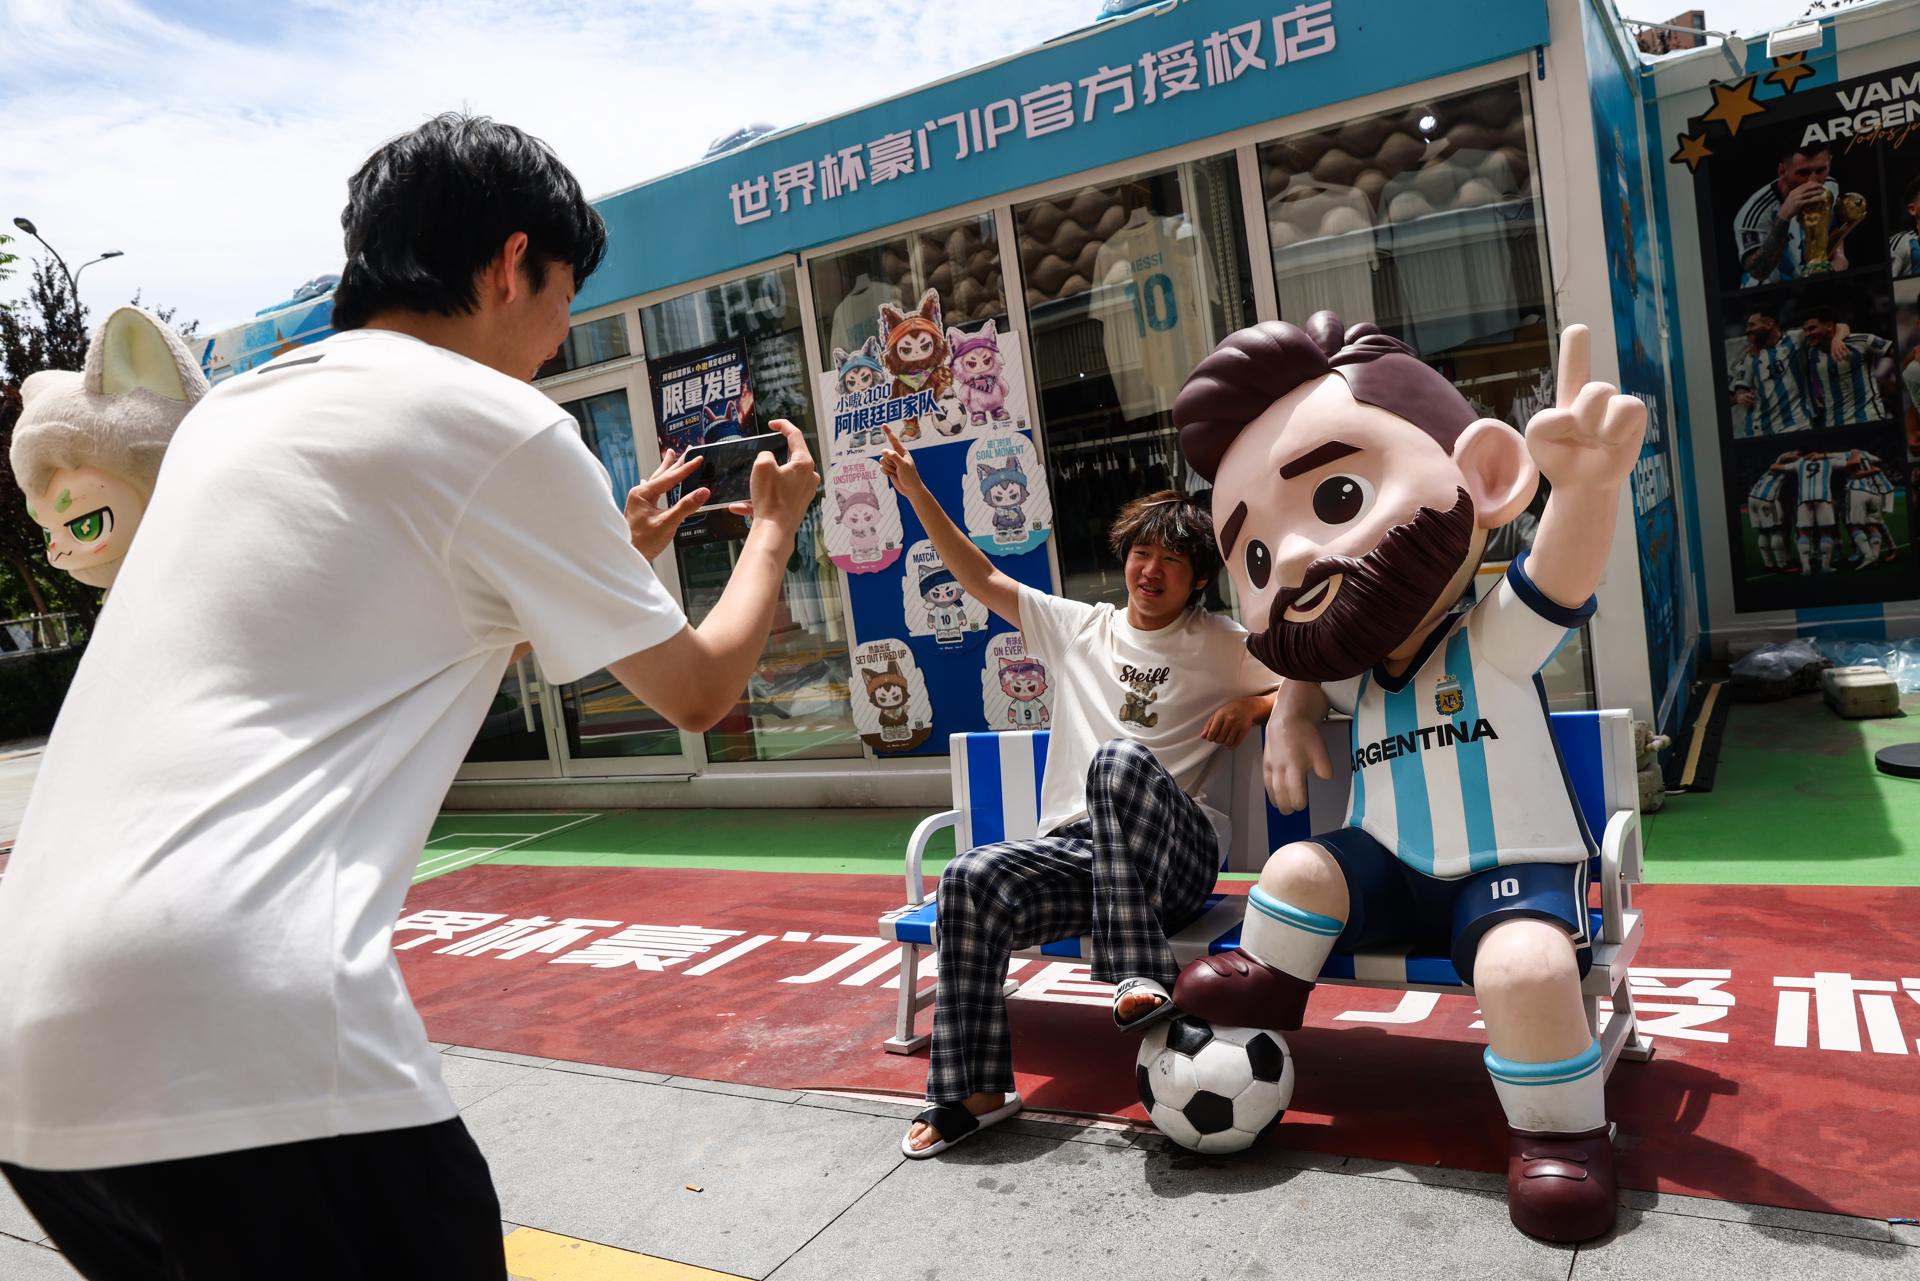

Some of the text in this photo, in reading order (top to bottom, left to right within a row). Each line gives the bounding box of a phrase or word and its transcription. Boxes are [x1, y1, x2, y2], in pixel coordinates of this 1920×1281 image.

[729, 1, 1337, 226] 世界杯豪门IP官方授权店
[1126, 251, 1163, 274] MESSI
[1124, 273, 1178, 338] 10
[662, 364, 743, 422] 限量发售
[835, 389, 941, 441] 阿根廷国家队
[976, 444, 1024, 460] GOAL MOMENT
[833, 469, 877, 485] UNSTOPPABLE
[1806, 462, 1821, 480] 9
[913, 551, 935, 563] MATCH
[941, 614, 951, 625] 10
[855, 649, 907, 665] SET OUT FIRED UP
[993, 646, 1004, 656] ON
[1119, 664, 1170, 684] Steiff
[1024, 709, 1032, 720] 9
[1490, 878, 1520, 900] 10
[1117, 980, 1139, 996] NIKE
